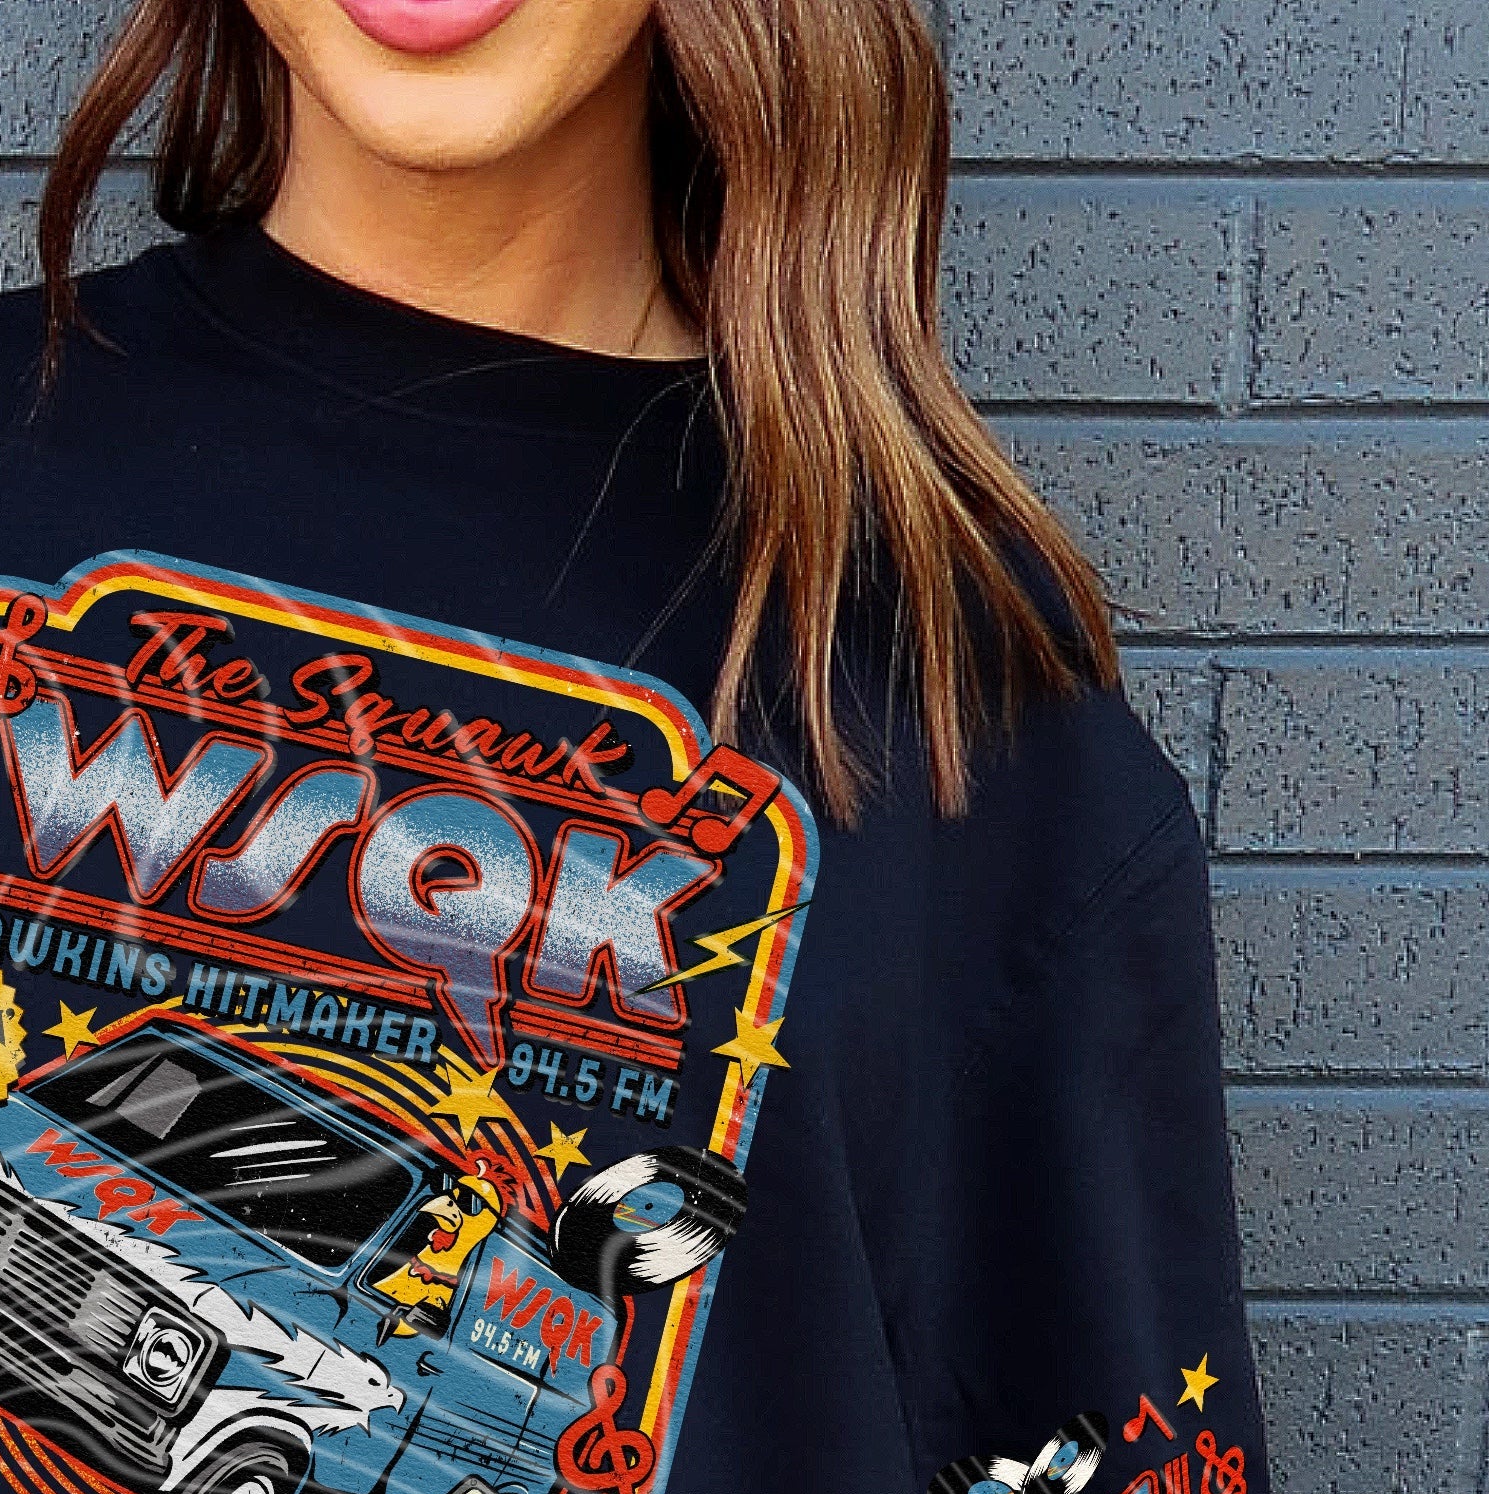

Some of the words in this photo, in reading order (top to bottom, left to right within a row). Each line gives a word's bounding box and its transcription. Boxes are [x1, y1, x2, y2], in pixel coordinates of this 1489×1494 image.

[125, 611, 266, 698] The
[283, 653, 628, 795] Squawk
[0, 692, 724, 1069] WSQK
[183, 964, 441, 1065] HITMAKER
[508, 1043, 601, 1103] 94.5
[612, 1067, 676, 1122] FM
[25, 1127, 206, 1236] WSQK
[470, 1317, 512, 1353] 94.5
[513, 1338, 542, 1371] FM
[483, 1256, 604, 1378] WSQK
